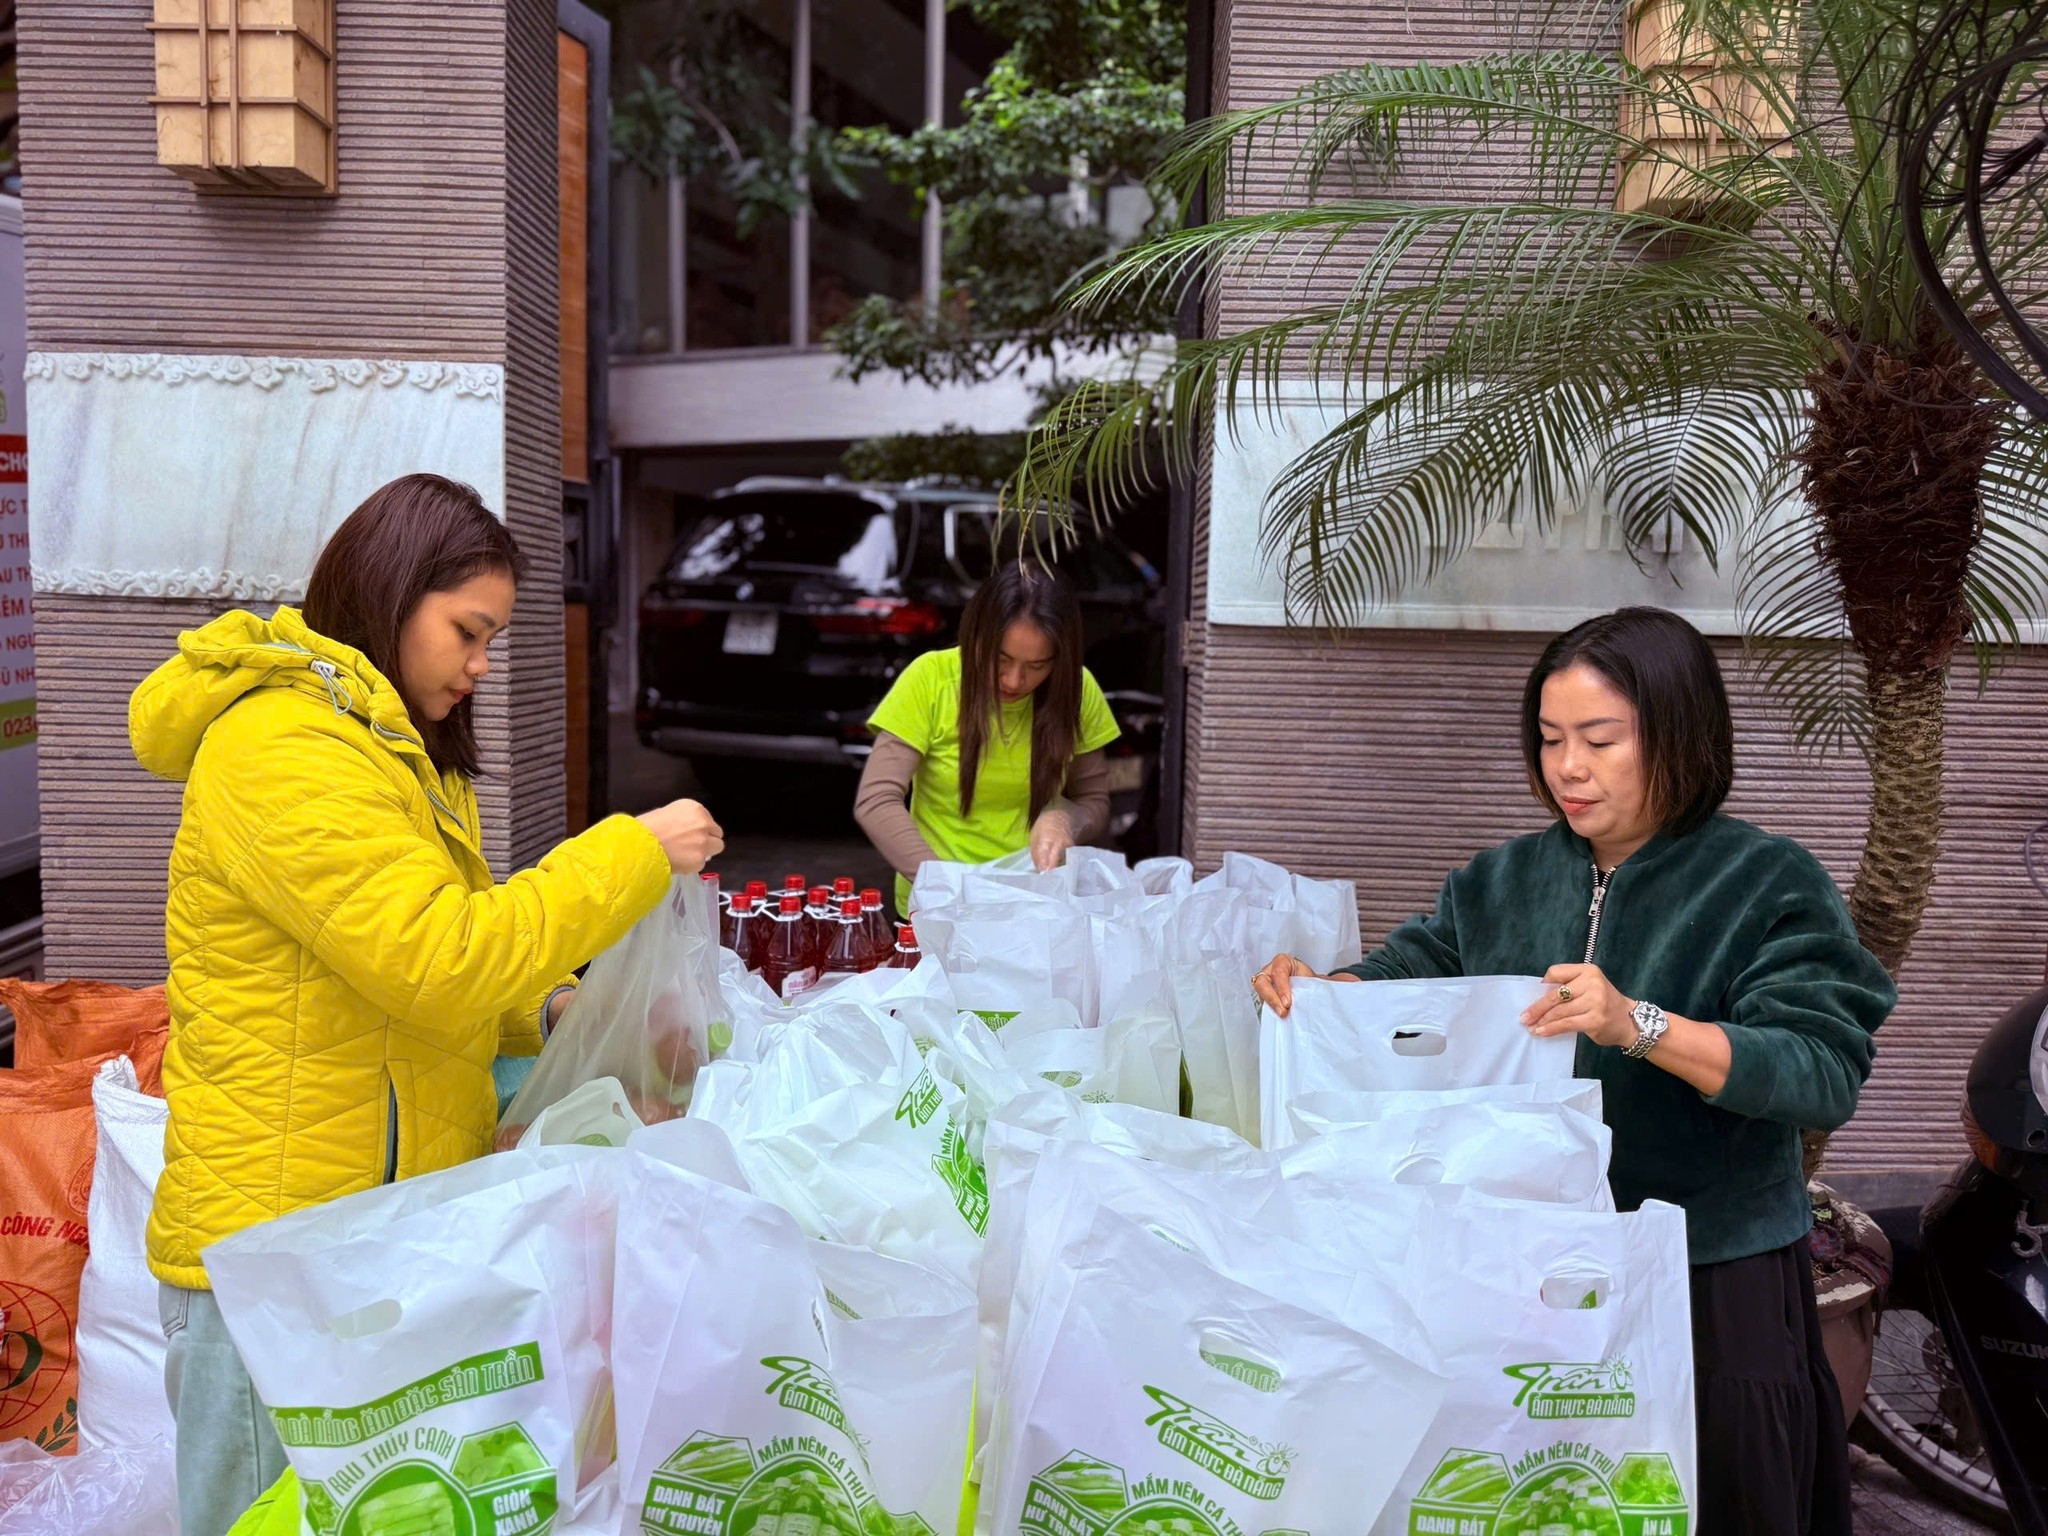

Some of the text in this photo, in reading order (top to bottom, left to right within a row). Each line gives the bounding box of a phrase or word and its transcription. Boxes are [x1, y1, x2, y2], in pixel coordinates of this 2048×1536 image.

[1, 1211, 55, 1237] CÔNG
[360, 1407, 395, 1437] ĂN
[393, 1384, 439, 1420] ĐẶC
[438, 1366, 478, 1402] SẢN
[481, 1349, 536, 1392] TRẦN
[1554, 1398, 1586, 1418] THỰC
[1585, 1395, 1602, 1416] ĐÀ
[328, 1461, 365, 1497] RAU
[415, 1427, 457, 1460] CANH
[757, 1434, 868, 1500] MẮM NÊM CÁ THU
[1189, 1438, 1224, 1473] THỰC
[1223, 1463, 1245, 1487] ĐÀ
[1512, 1440, 1615, 1478] MẮM NÊM CÁ THU
[652, 1485, 694, 1508] DANH
[1033, 1489, 1069, 1520] DANH
[1131, 1472, 1246, 1536] MẮM NÊM CÁ TH
[1416, 1515, 1456, 1534] DANH
